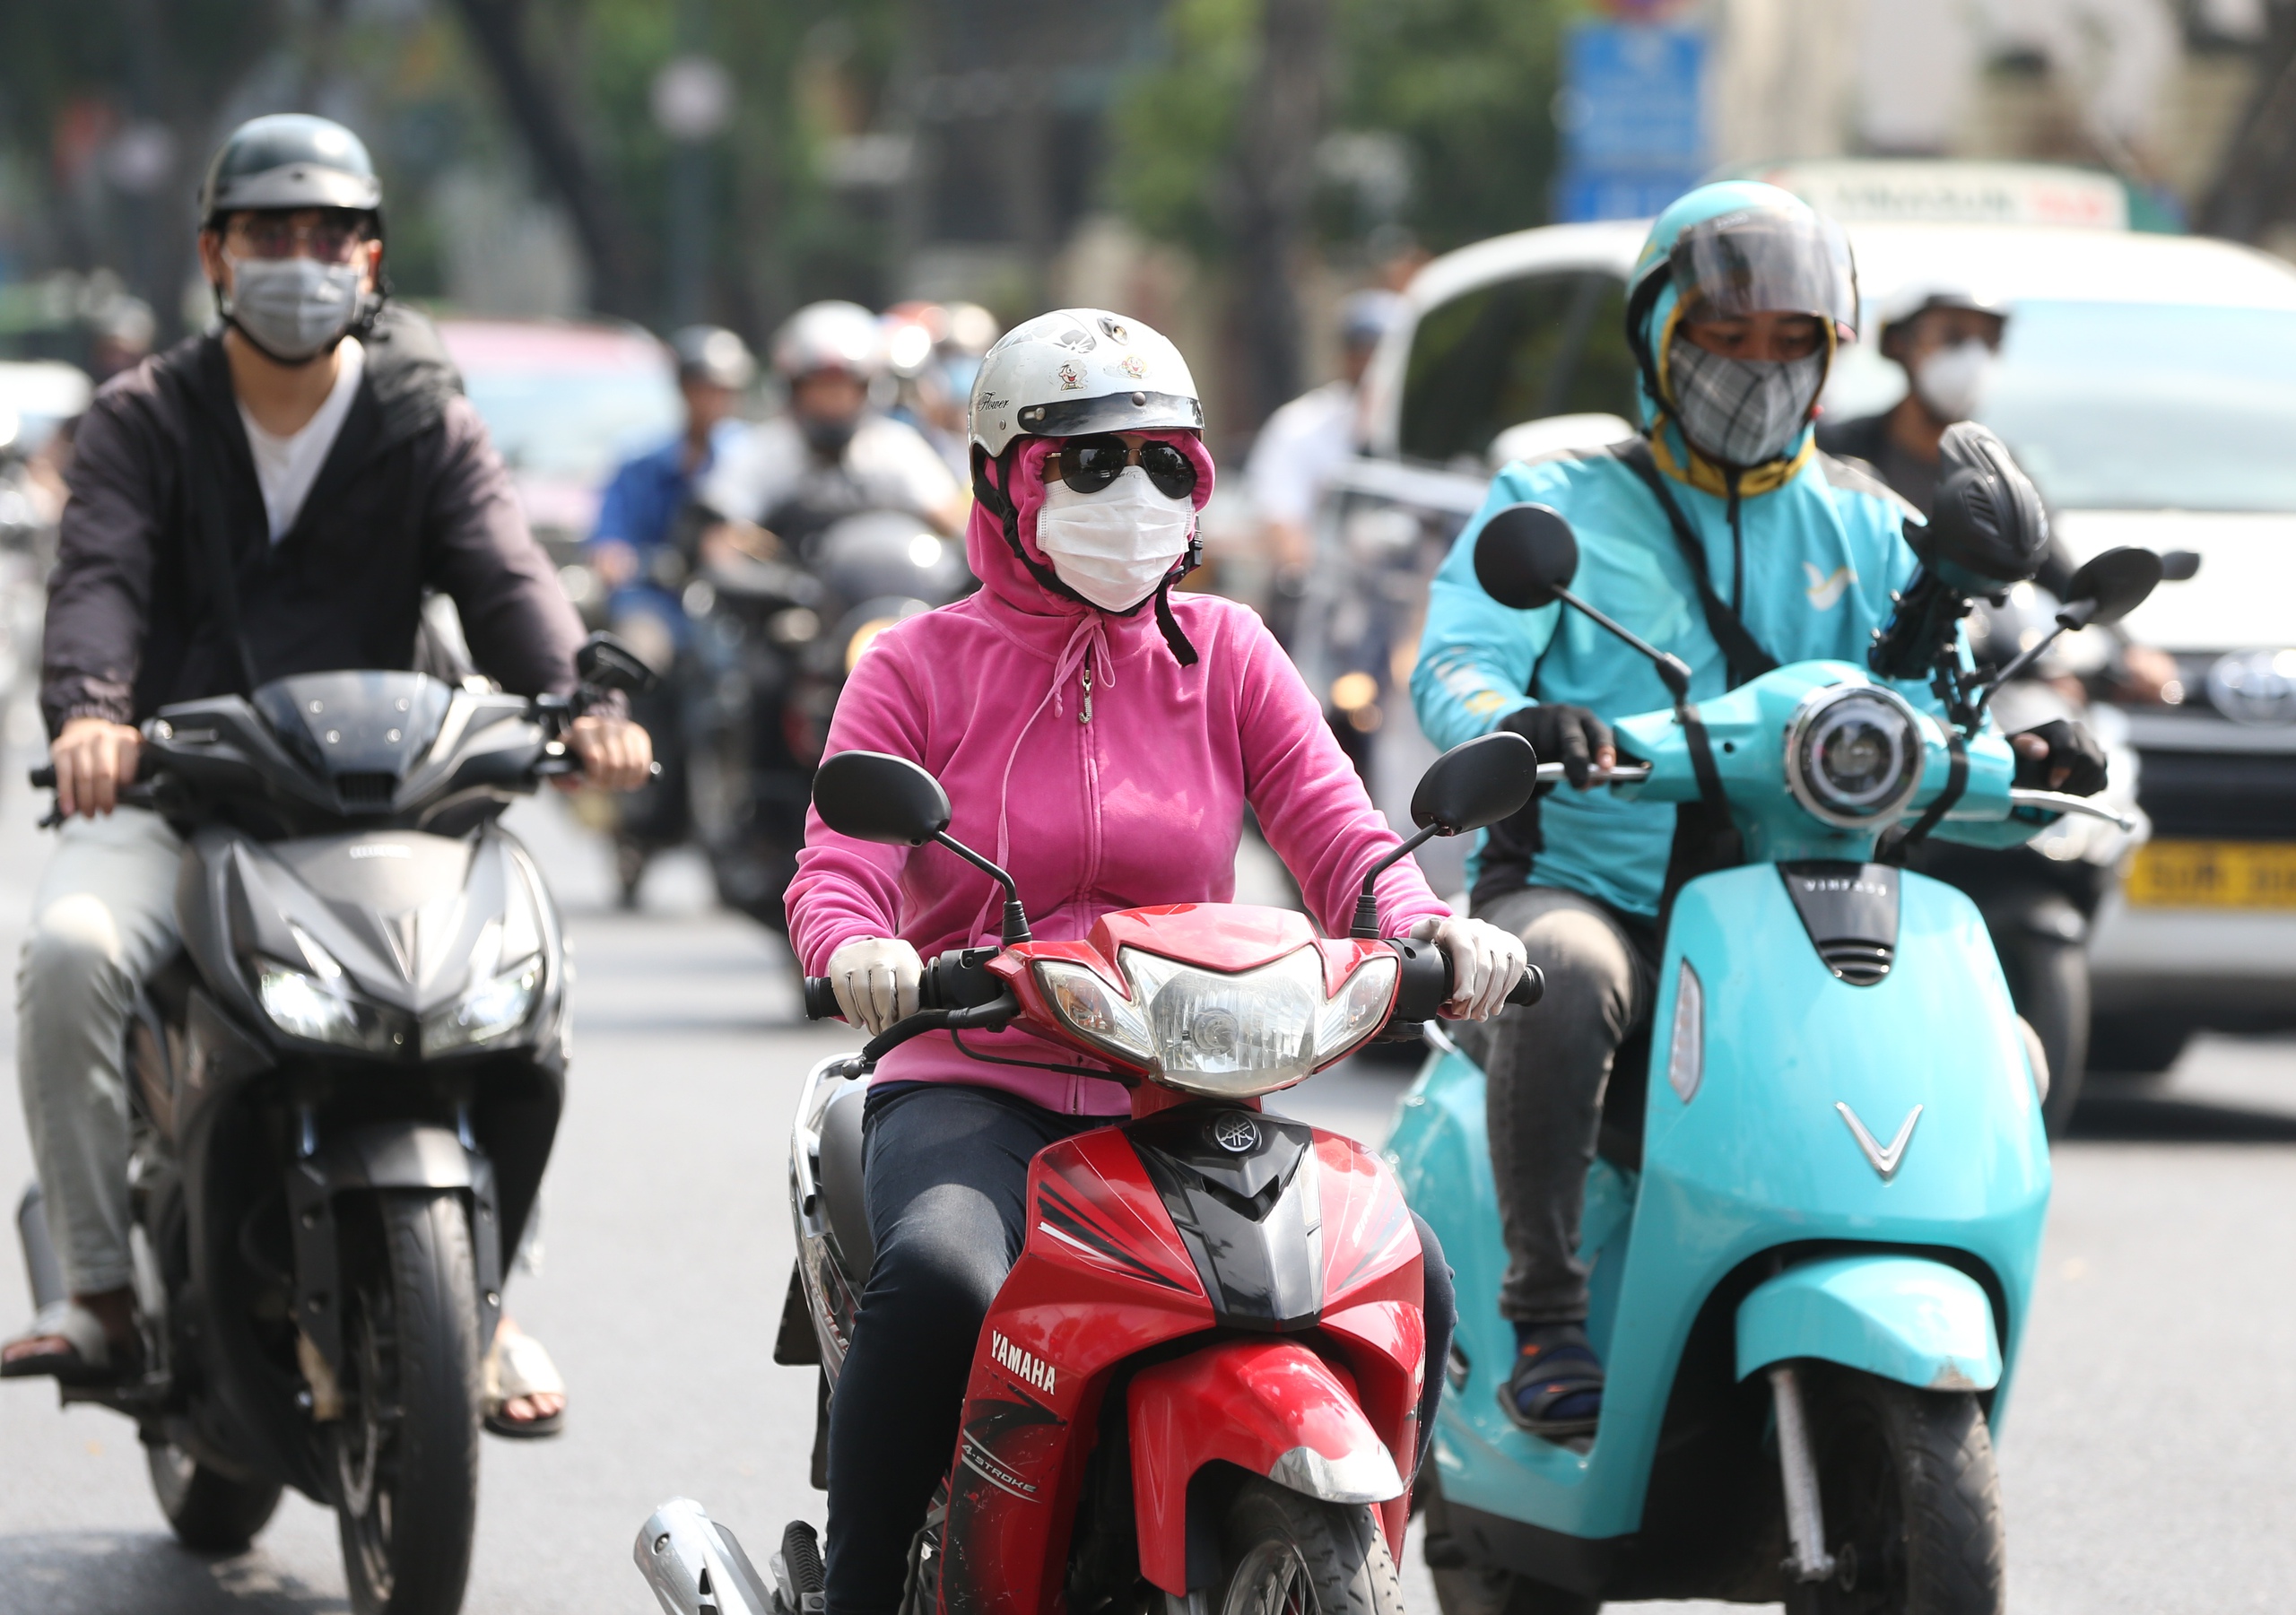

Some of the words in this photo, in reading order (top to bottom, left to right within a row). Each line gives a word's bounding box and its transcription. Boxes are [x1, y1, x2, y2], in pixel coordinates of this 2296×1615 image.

[978, 391, 1010, 412] Flower
[991, 1329, 1056, 1396] YAMAHA
[961, 1444, 1038, 1493] 4-STROKE
